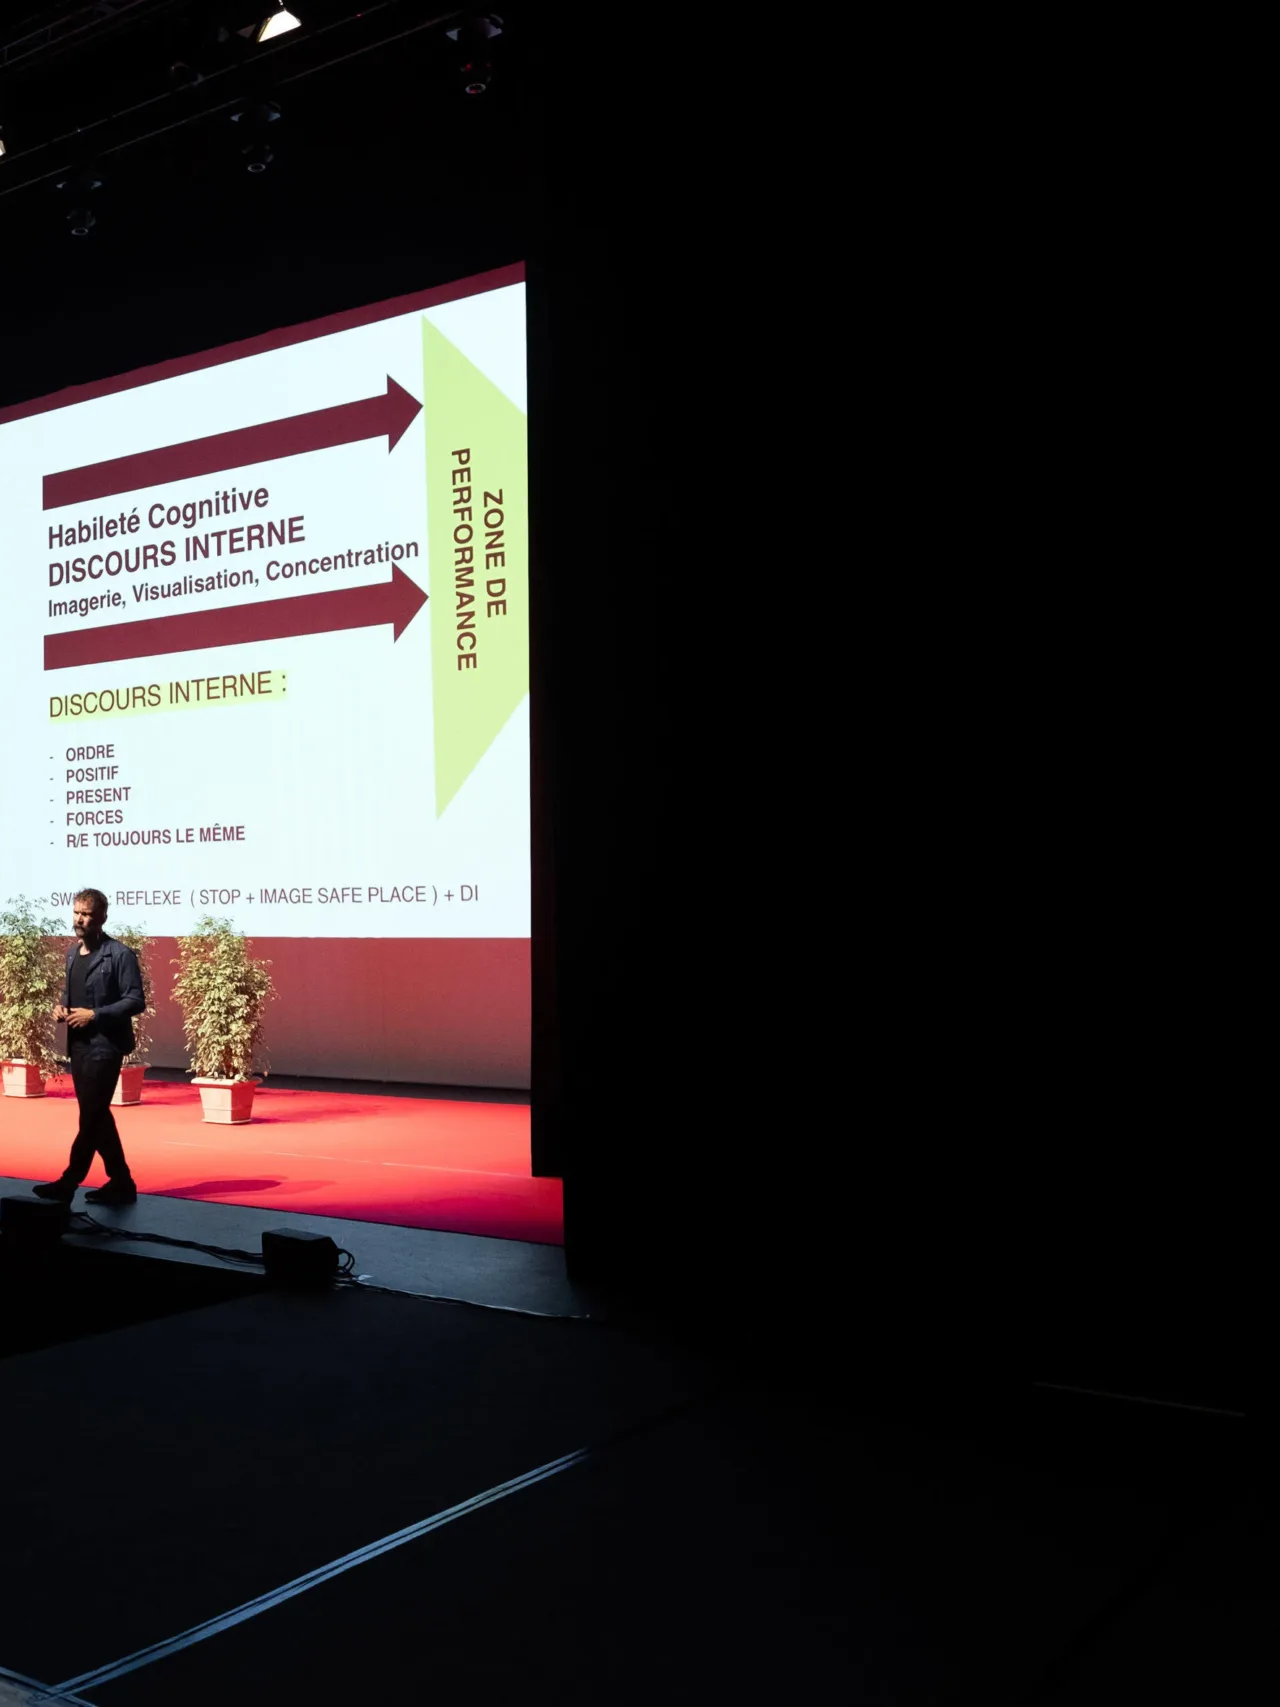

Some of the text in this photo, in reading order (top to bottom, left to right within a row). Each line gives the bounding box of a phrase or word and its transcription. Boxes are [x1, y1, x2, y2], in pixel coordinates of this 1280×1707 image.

[49, 487, 269, 550] Habileté Cognitive
[49, 515, 305, 587] DISCOURS INTERNE
[451, 448, 477, 671] PERFORMANCE
[483, 489, 507, 618] ZONE DE
[49, 541, 418, 617] Imagerie, Visualisation, Concentration
[50, 684, 161, 718] DISCOURS
[170, 670, 272, 704] INTERNE
[66, 744, 115, 762] ORDRE
[66, 765, 119, 783] POSITIF
[67, 786, 131, 805] PRESENT
[67, 809, 123, 826] FORCES
[67, 823, 245, 848] R/E TOUJOURS LE MÊME
[116, 890, 181, 905] REFLEXE
[200, 889, 240, 905] STOP
[260, 888, 312, 904] IMAGE
[318, 887, 362, 904] SAFE
[368, 886, 426, 902] PLACE
[460, 885, 478, 901] DI
